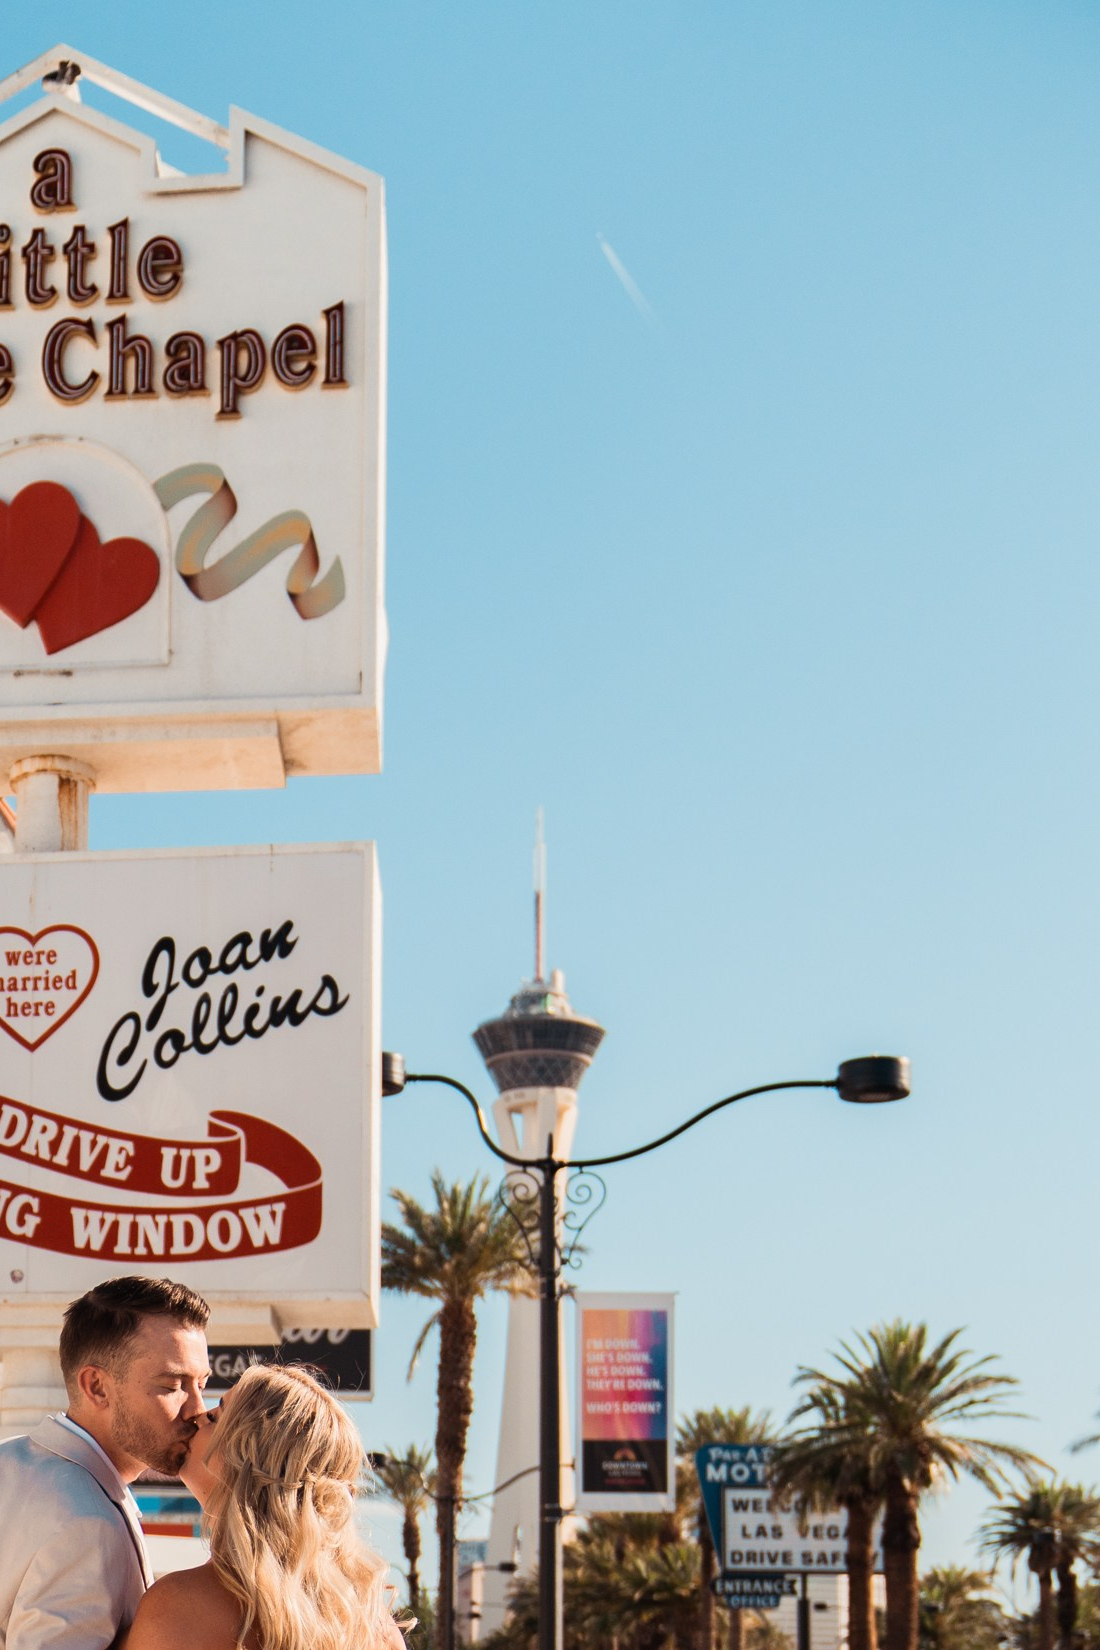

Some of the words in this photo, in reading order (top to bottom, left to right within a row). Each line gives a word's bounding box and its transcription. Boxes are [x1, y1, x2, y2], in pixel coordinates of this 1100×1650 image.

[30, 147, 76, 214] a
[41, 300, 349, 420] Chapel
[5, 949, 58, 966] were
[142, 919, 299, 1032] Joan
[5, 996, 56, 1018] here
[96, 974, 350, 1102] Collins
[160, 1146, 222, 1189] UP
[70, 1202, 286, 1256] WINDOW
[741, 1525, 784, 1540] LAS
[730, 1551, 793, 1566] DRIVE
[716, 1579, 791, 1595] ENTRANCE
